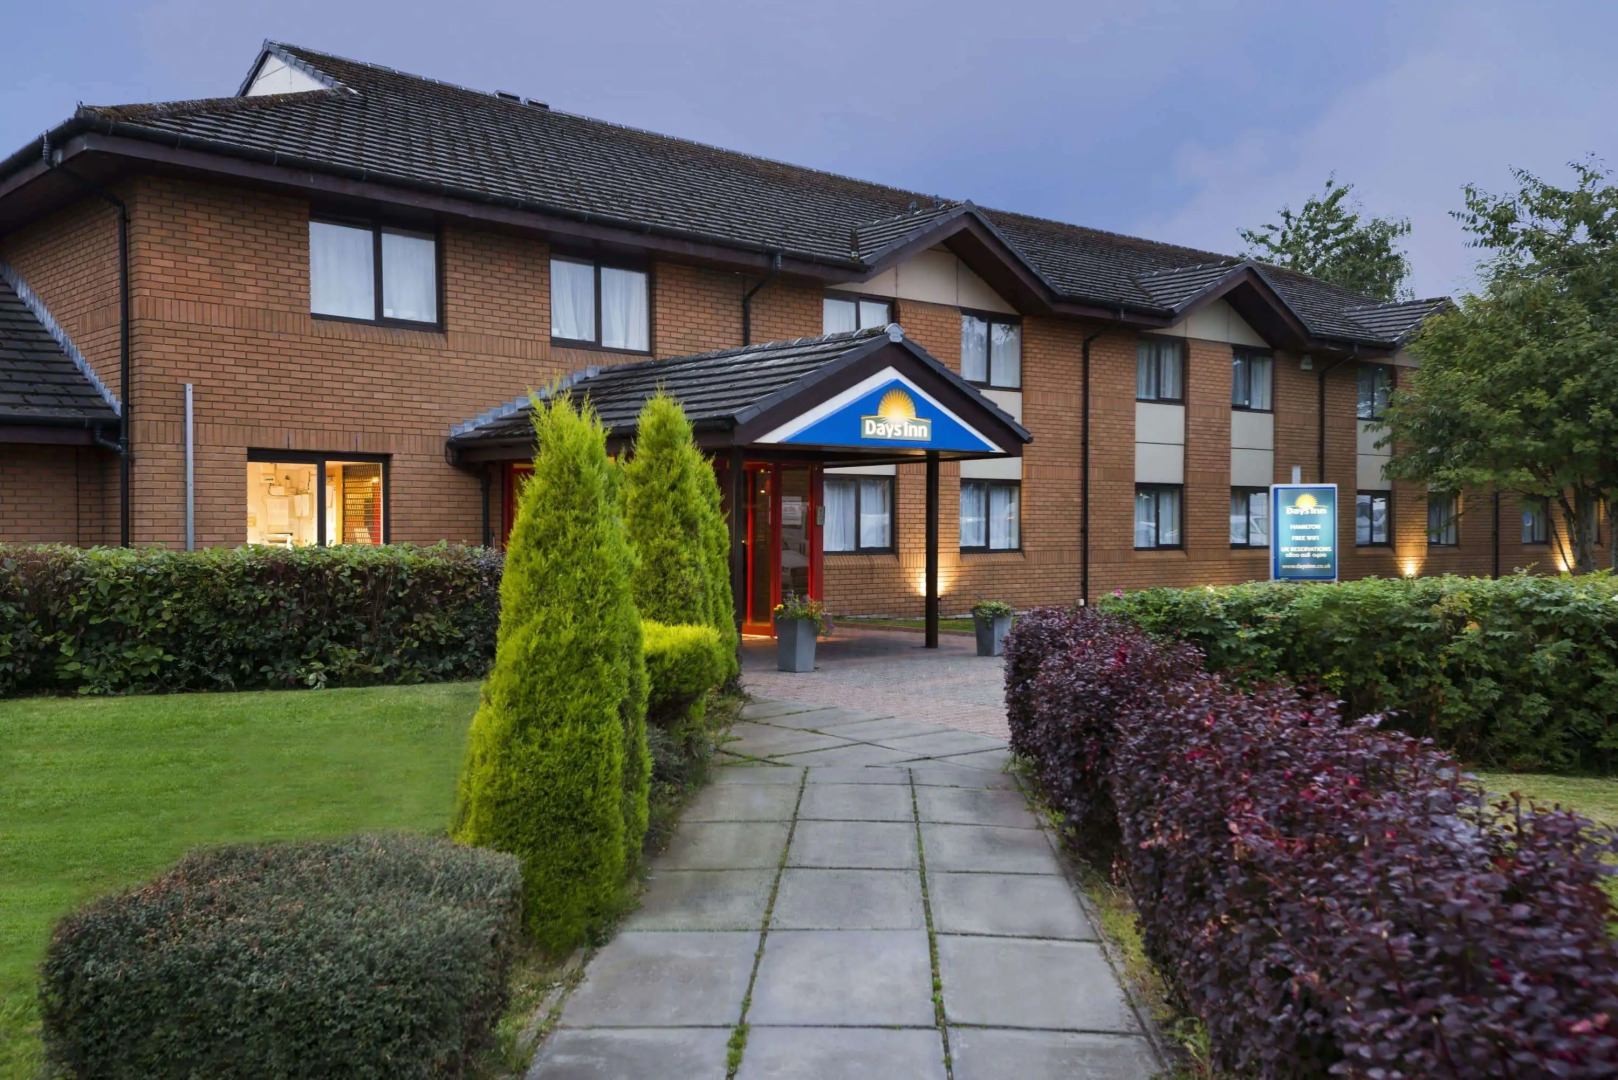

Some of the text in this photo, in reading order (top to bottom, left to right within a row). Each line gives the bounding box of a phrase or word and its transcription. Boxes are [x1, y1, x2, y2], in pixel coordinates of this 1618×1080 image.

[865, 420, 927, 438] Days Inn
[1286, 507, 1311, 516] Days
